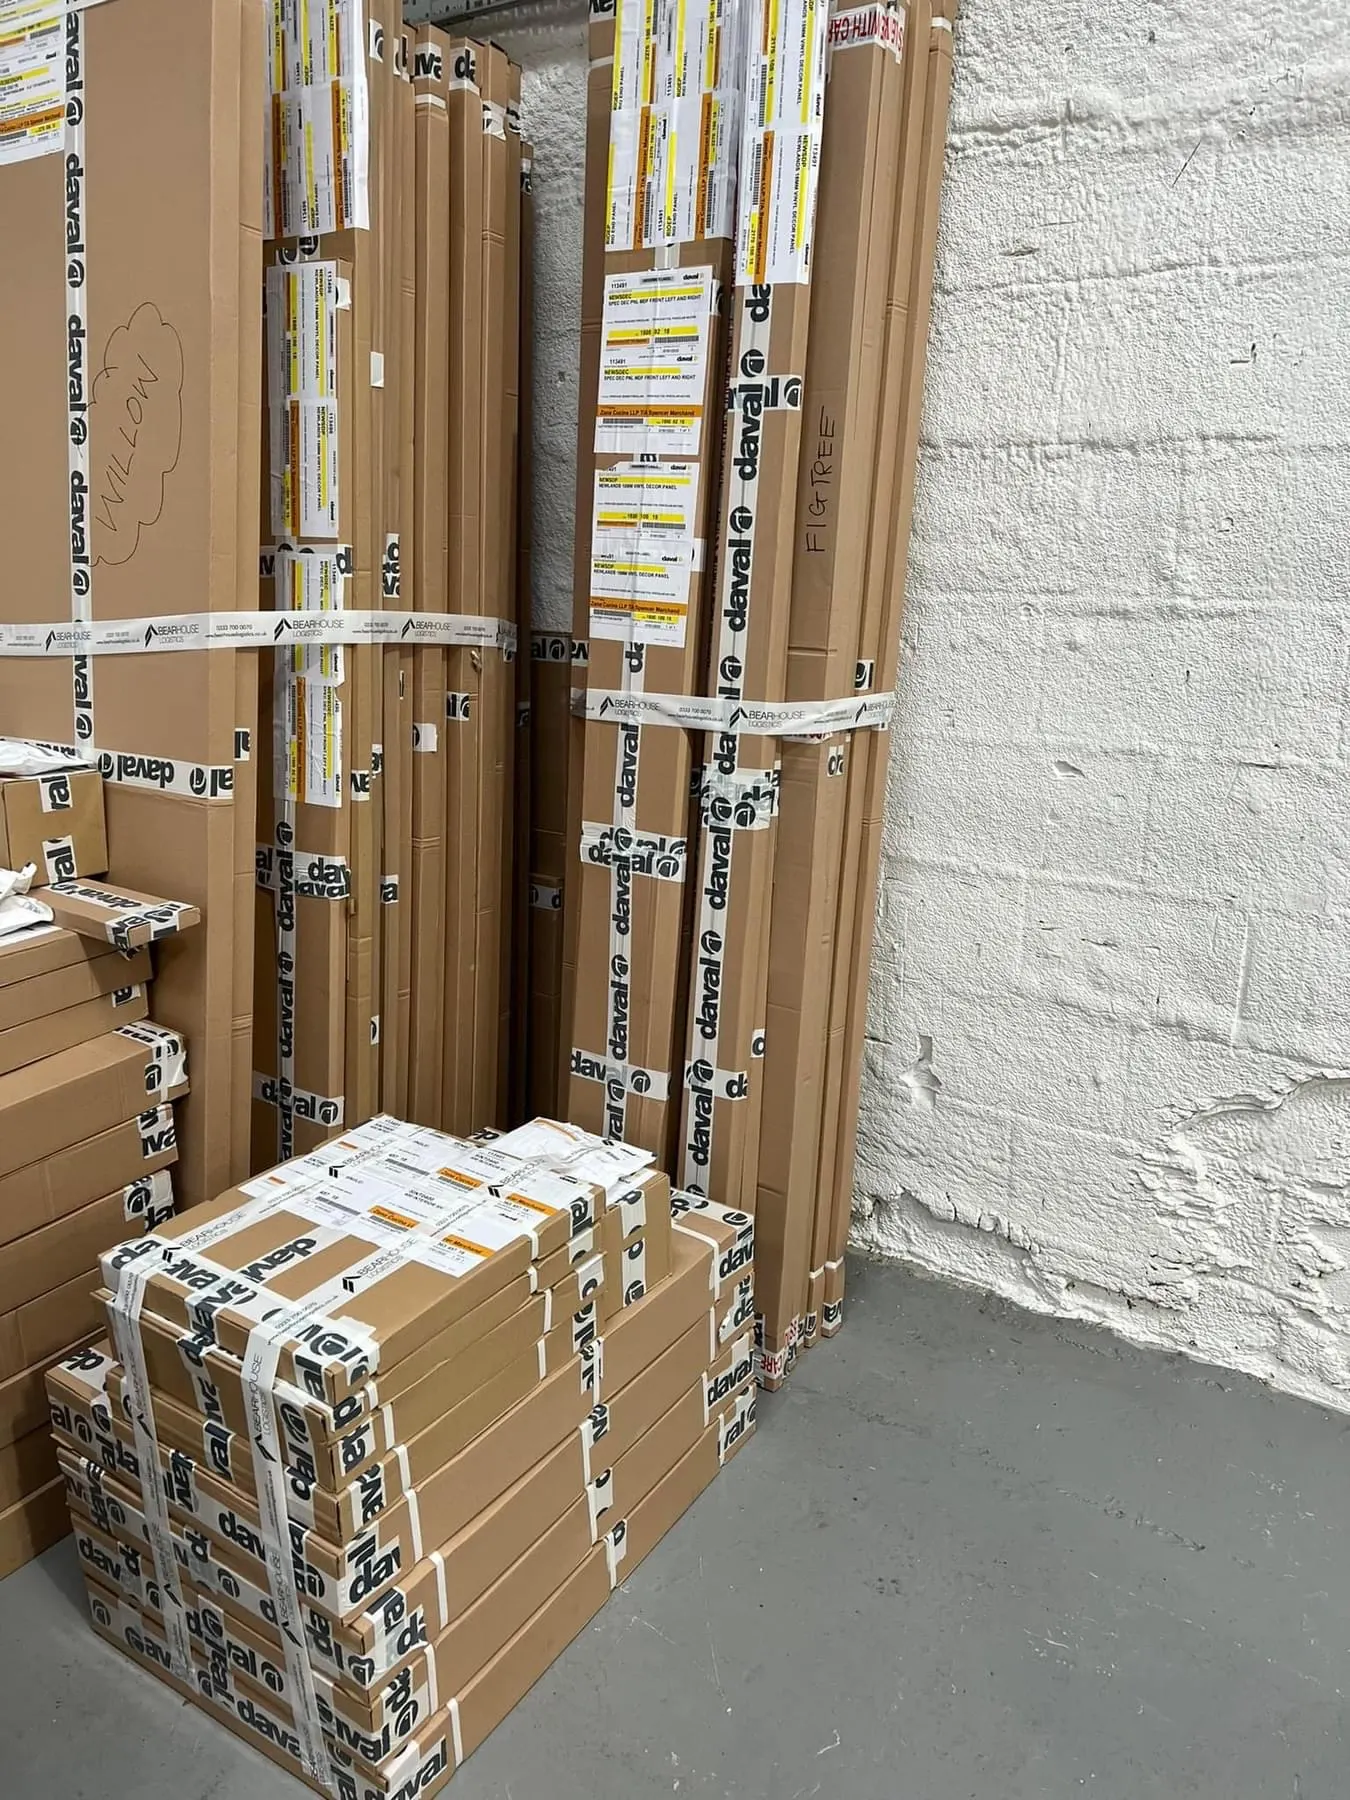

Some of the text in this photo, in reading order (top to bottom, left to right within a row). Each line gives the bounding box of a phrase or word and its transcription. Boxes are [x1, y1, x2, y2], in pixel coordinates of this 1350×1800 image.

[66, 153, 85, 254] daval
[67, 314, 87, 412] daval
[95, 353, 159, 531] WILLOW
[733, 384, 763, 480] daval
[70, 470, 89, 564] daval
[293, 619, 344, 629] BEARHOUSE
[723, 539, 752, 631] daval
[56, 631, 91, 640] BEARHOUSE
[158, 624, 199, 636] BEARHOUSE
[415, 621, 451, 630] BEARHOUSE
[614, 700, 660, 712] BEARHOUSE
[614, 709, 642, 717] LOGISTICS
[748, 710, 805, 721] BEARHOUSE
[748, 720, 782, 728] LOGISTICS
[117, 754, 174, 788] daval
[616, 721, 640, 808] daval
[277, 851, 295, 931] daval
[612, 853, 631, 936] daval
[704, 825, 732, 909] daval
[279, 979, 295, 1058] daval
[608, 980, 629, 1061] daval
[695, 958, 722, 1040] daval
[688, 1085, 713, 1166] daval
[358, 1237, 418, 1276] BEARHOUSE
